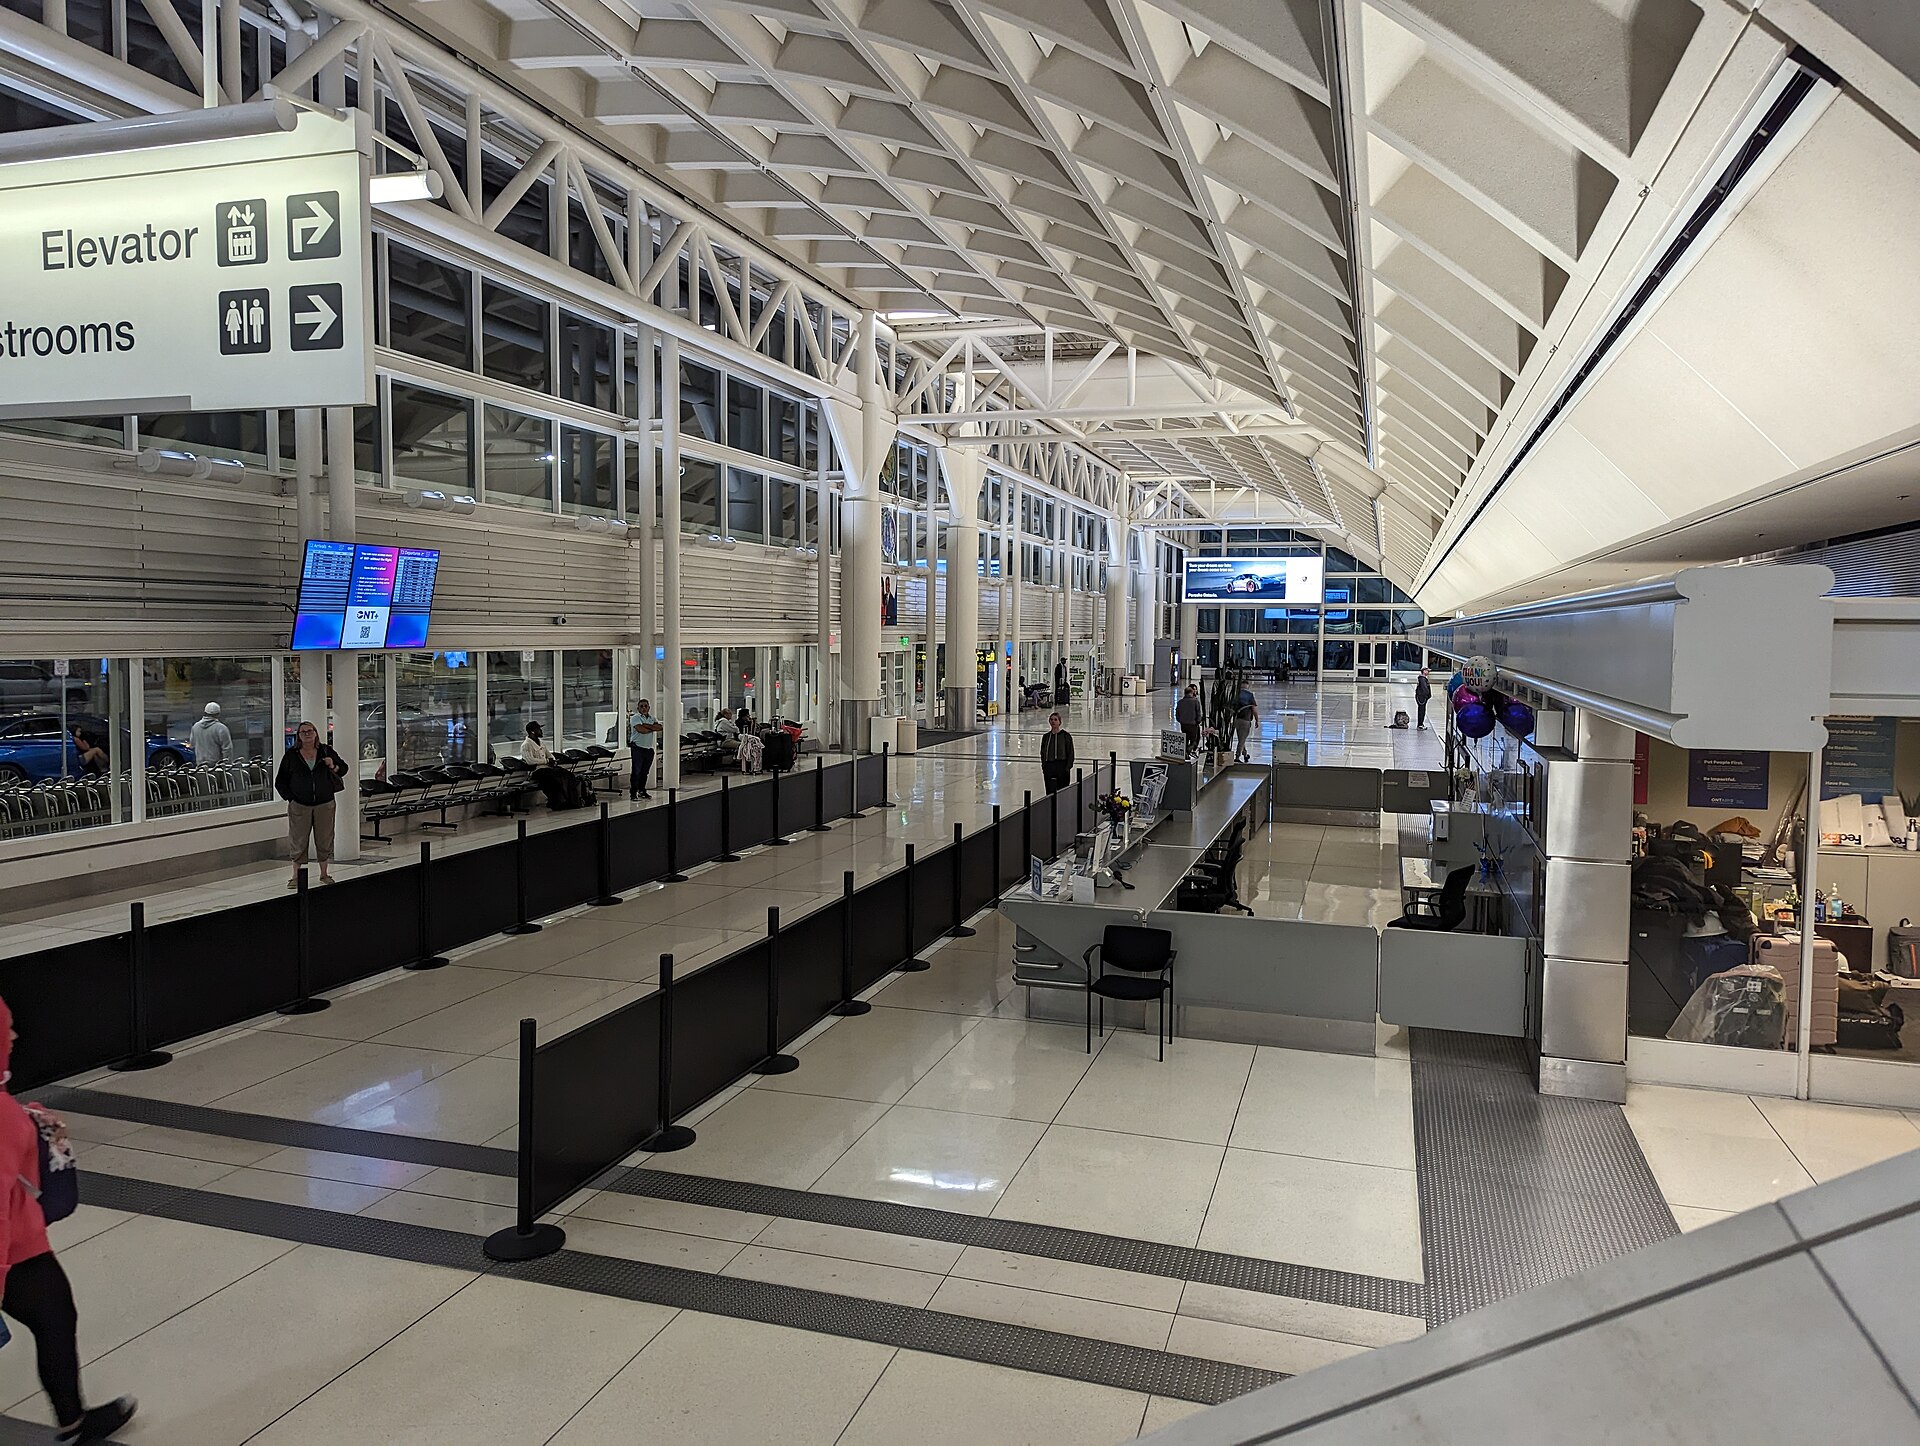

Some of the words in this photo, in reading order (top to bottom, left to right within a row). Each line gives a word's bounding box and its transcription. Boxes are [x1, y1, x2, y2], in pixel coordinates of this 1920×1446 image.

[42, 223, 199, 271] Elevator
[0, 320, 136, 358] trooms
[1462, 667, 1486, 678] THANK
[1465, 677, 1483, 687] YOU!
[1163, 731, 1184, 745] Baggage
[1170, 745, 1184, 756] Claim
[1821, 832, 1862, 845] FedEx
